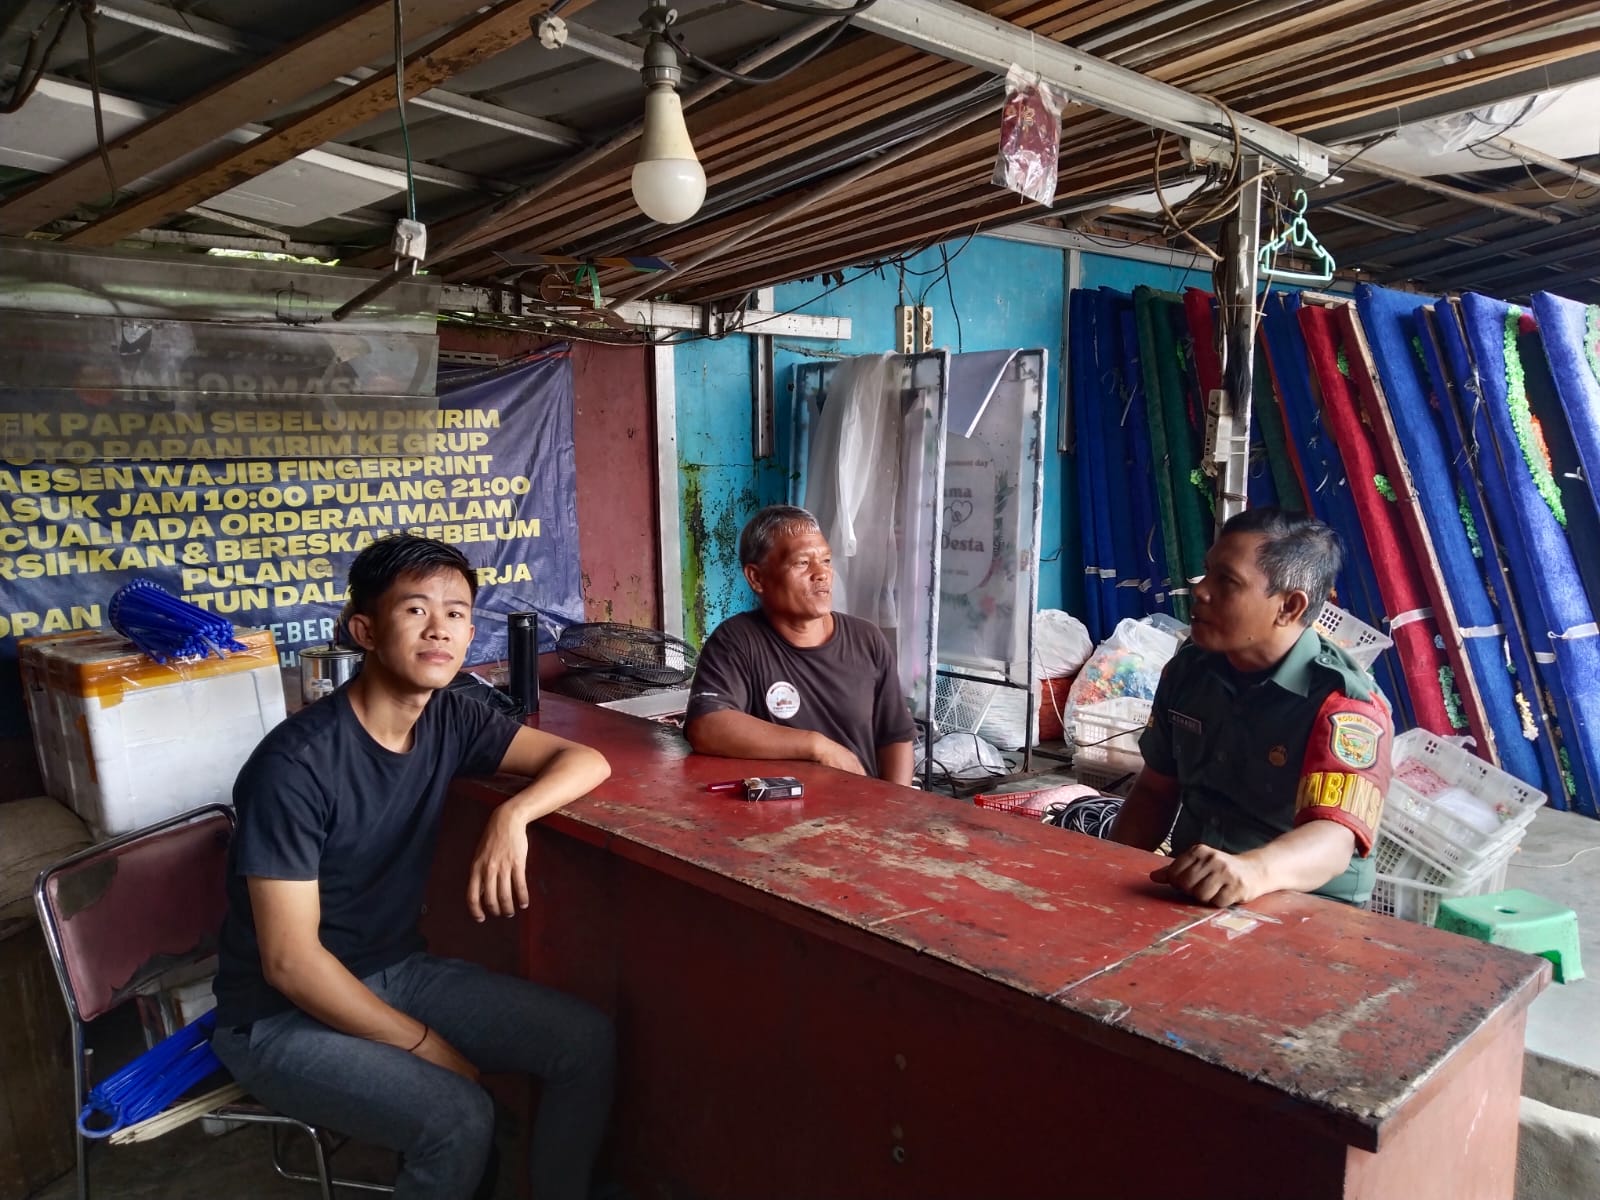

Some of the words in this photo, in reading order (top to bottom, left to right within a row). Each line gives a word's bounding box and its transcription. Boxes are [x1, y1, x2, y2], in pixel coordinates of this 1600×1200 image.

[60, 411, 204, 436] PAPAN
[211, 410, 377, 433] SEBELUM
[383, 408, 500, 431] DIKIRIM
[103, 436, 244, 463] PAPAN
[250, 434, 352, 457] KIRIM
[357, 434, 398, 455] KE
[403, 432, 489, 454] GRUP
[0, 467, 135, 494] ABSEN
[138, 461, 274, 489] WAJIB
[278, 455, 493, 482] FINGERPRINT
[107, 491, 197, 517] JAM
[203, 486, 308, 511] 10:00
[313, 479, 447, 505] PULANG
[451, 475, 531, 498] 21:00
[0, 520, 123, 552] CUALI
[130, 515, 215, 542] ADA
[220, 506, 393, 536] ORDERAN
[398, 499, 512, 525] MALAM
[182, 542, 210, 565] &
[216, 528, 401, 562] BERESKA
[182, 557, 333, 591] PULANG
[181, 587, 268, 613] TUN
